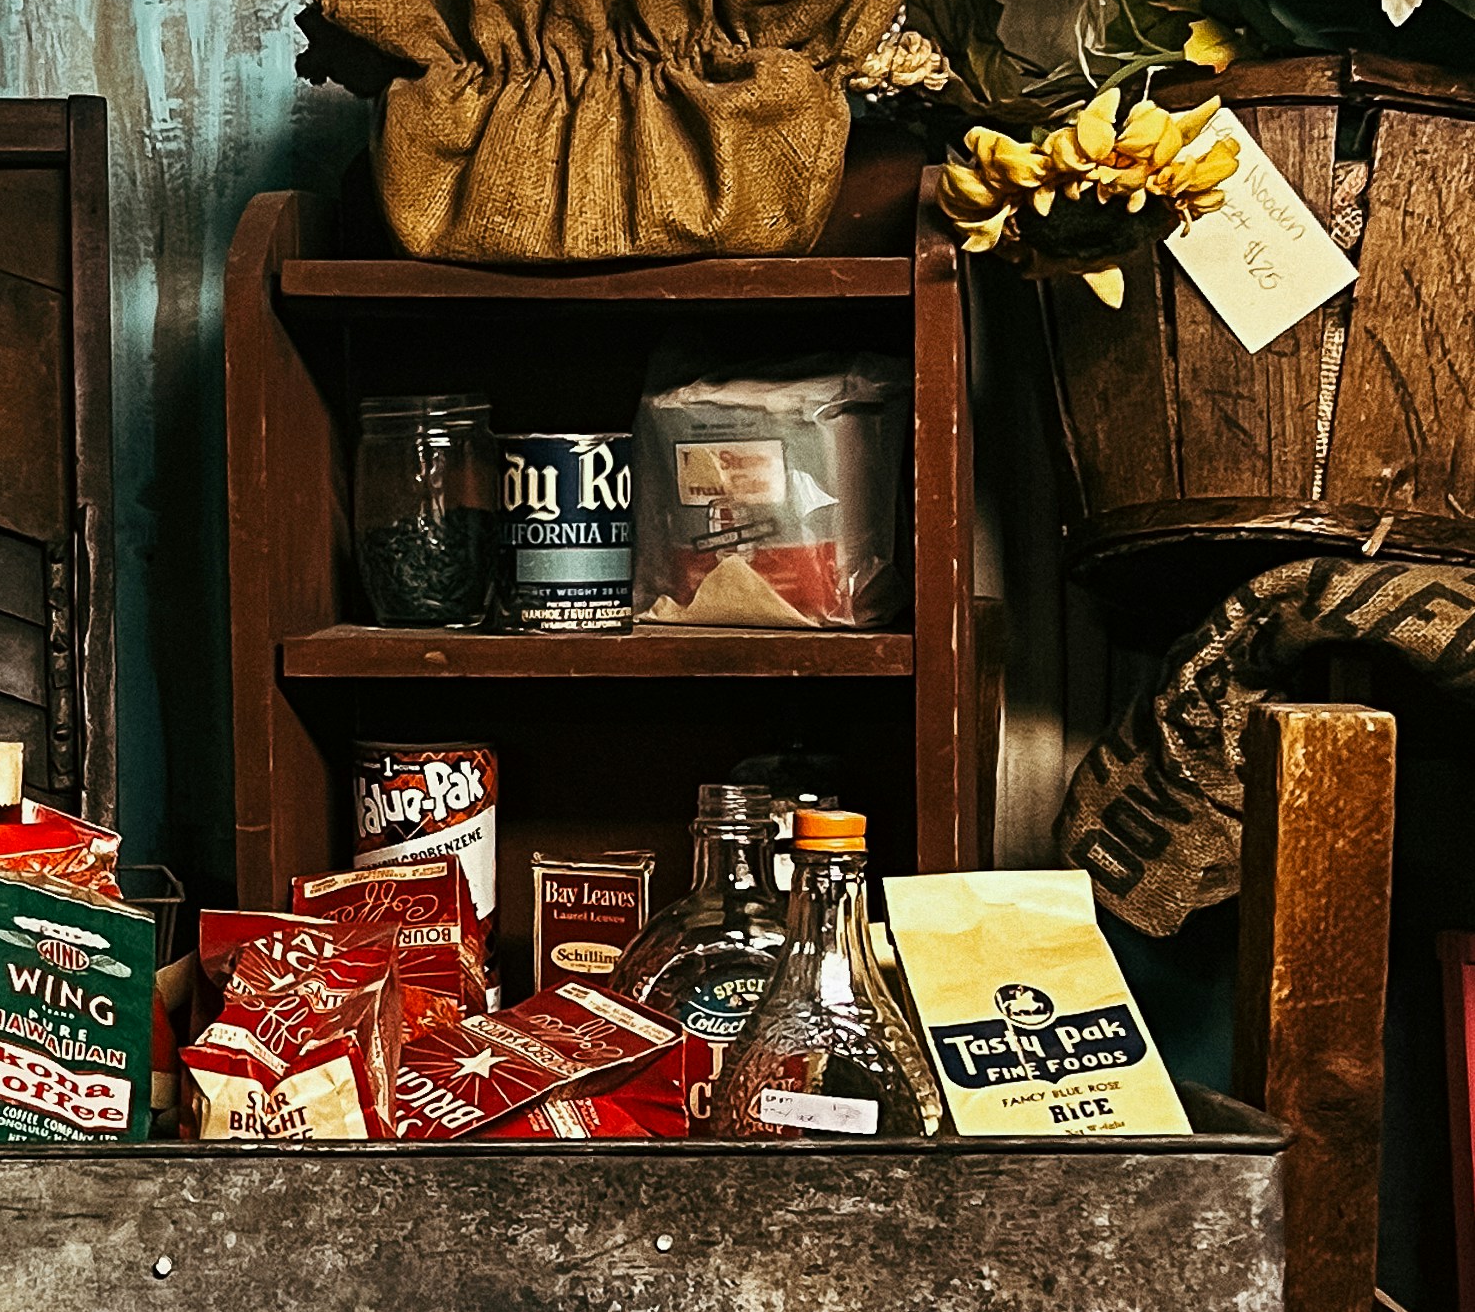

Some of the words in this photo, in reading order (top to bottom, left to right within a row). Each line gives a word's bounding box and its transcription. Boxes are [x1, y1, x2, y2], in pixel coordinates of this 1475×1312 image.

[1244, 164, 1307, 241] Wooden
[1243, 239, 1282, 290] $25
[556, 587, 598, 597] WEIGHT
[563, 607, 594, 620] FRUIT
[383, 756, 393, 777] 1
[355, 761, 484, 838] Value-Pak
[544, 879, 579, 908] Bay
[581, 881, 636, 909] Leaves
[552, 908, 589, 923] Laurel
[589, 911, 626, 924] Leaves
[6, 962, 115, 1027] WING
[28, 1007, 89, 1042] PURE
[942, 1030, 1046, 1077] Tasty
[1054, 1017, 1128, 1055] Pak
[986, 1064, 1041, 1083] FINE
[1045, 1049, 1129, 1074] FOODS
[1001, 1091, 1046, 1109] FANCY
[1052, 1086, 1084, 1099] BLUE
[1088, 1080, 1122, 1093] ROSE
[2, 1104, 39, 1126] COFFEE
[1048, 1097, 1114, 1125] RICE
